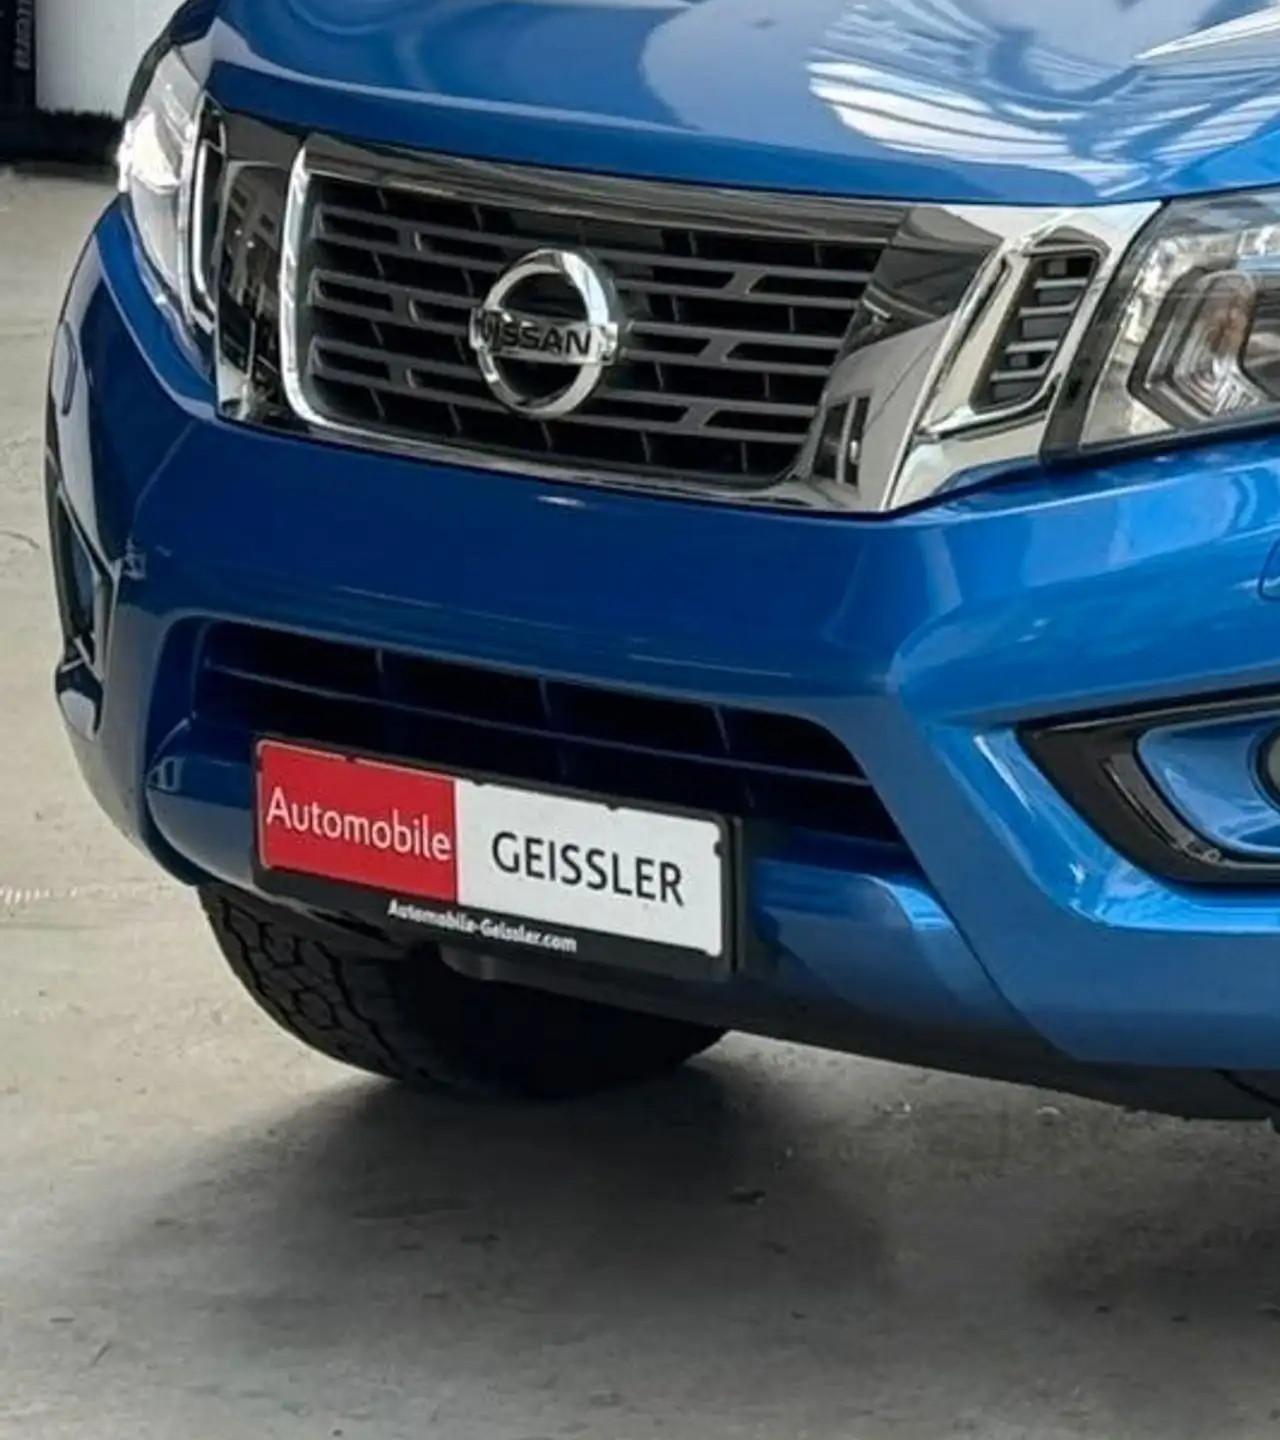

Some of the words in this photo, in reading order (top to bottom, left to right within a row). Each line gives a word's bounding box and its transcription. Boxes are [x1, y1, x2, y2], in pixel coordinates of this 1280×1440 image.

[265, 786, 454, 862] Automobile
[491, 831, 686, 907] GEISSLER
[386, 898, 578, 953] Automobile-Geissler.com
